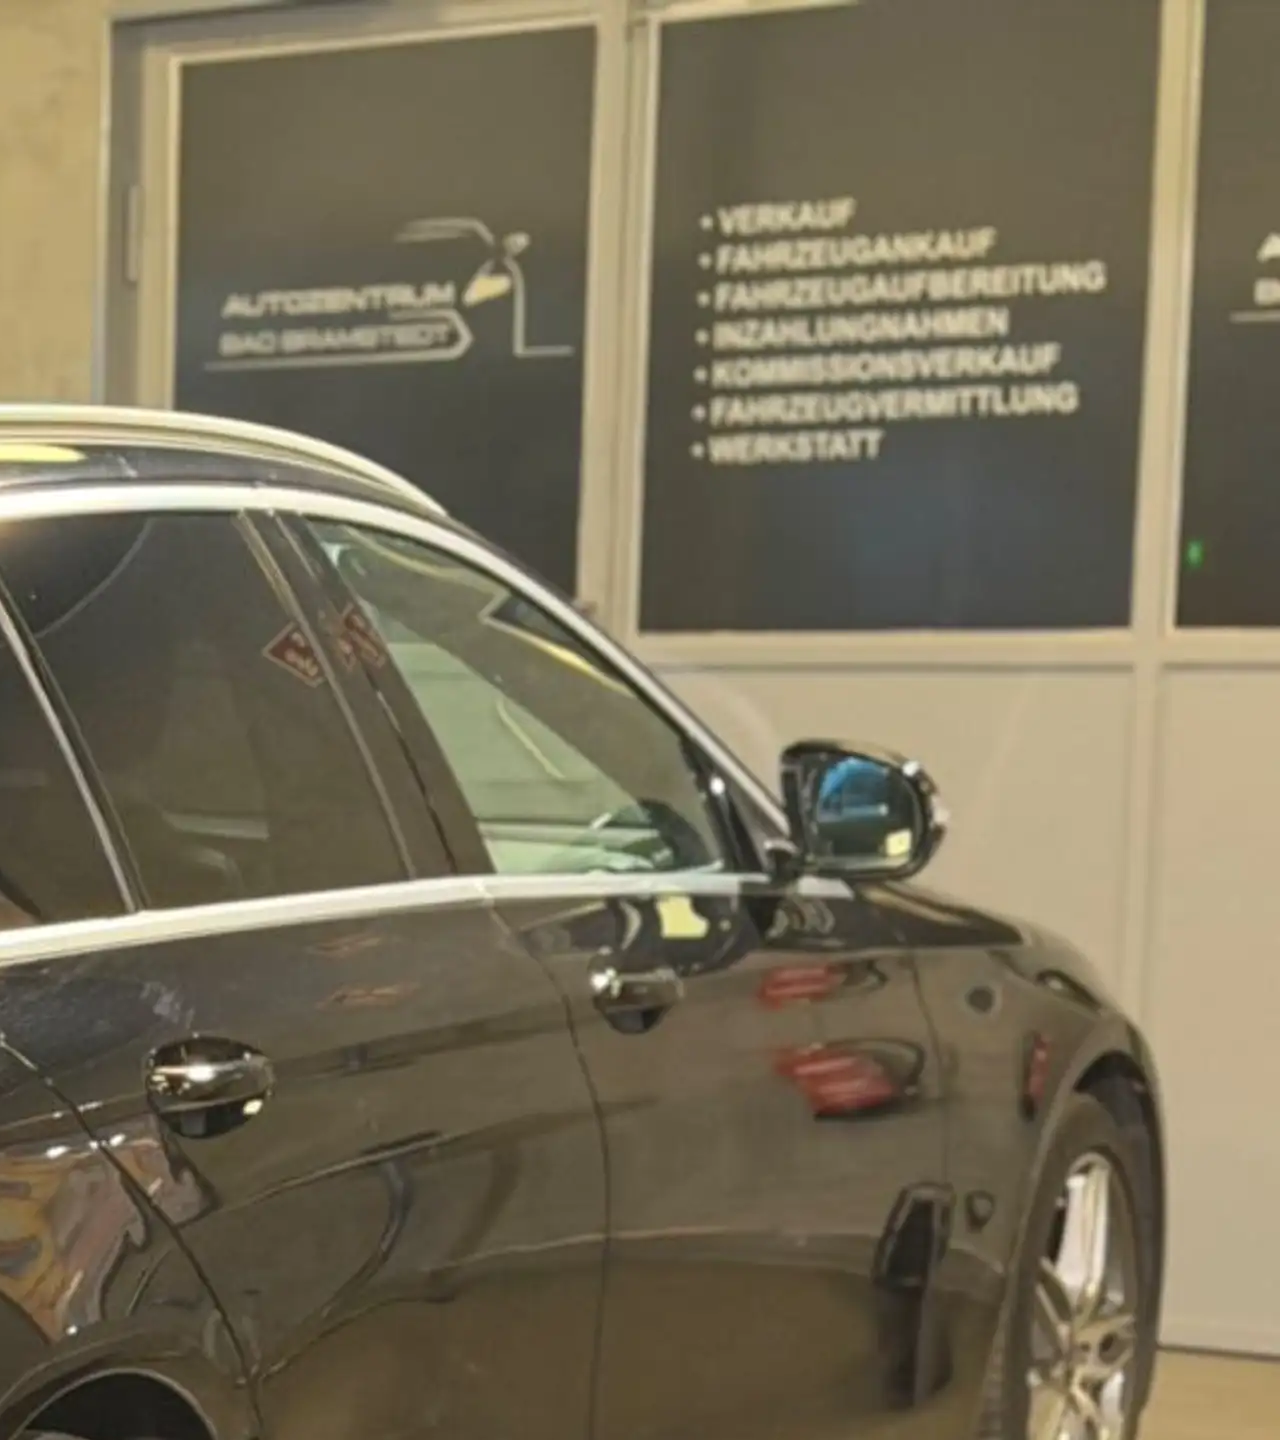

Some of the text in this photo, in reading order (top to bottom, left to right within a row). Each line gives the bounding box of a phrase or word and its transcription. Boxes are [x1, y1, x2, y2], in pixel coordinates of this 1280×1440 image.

[718, 197, 857, 236] VERKAUF
[714, 227, 998, 274] FAHRZEUGANKAUF
[220, 281, 455, 320] AUTOZENTRUM
[714, 262, 1108, 312] FAHRZEUGAUFBEREITUNG
[218, 322, 454, 358] BAD BRAMSTEDT
[711, 343, 1062, 388] KOMMISSIONSVERKAUF
[709, 383, 1080, 427] FAHRZEUGVERMITTLUNG
[707, 429, 885, 465] WERKSTATT
